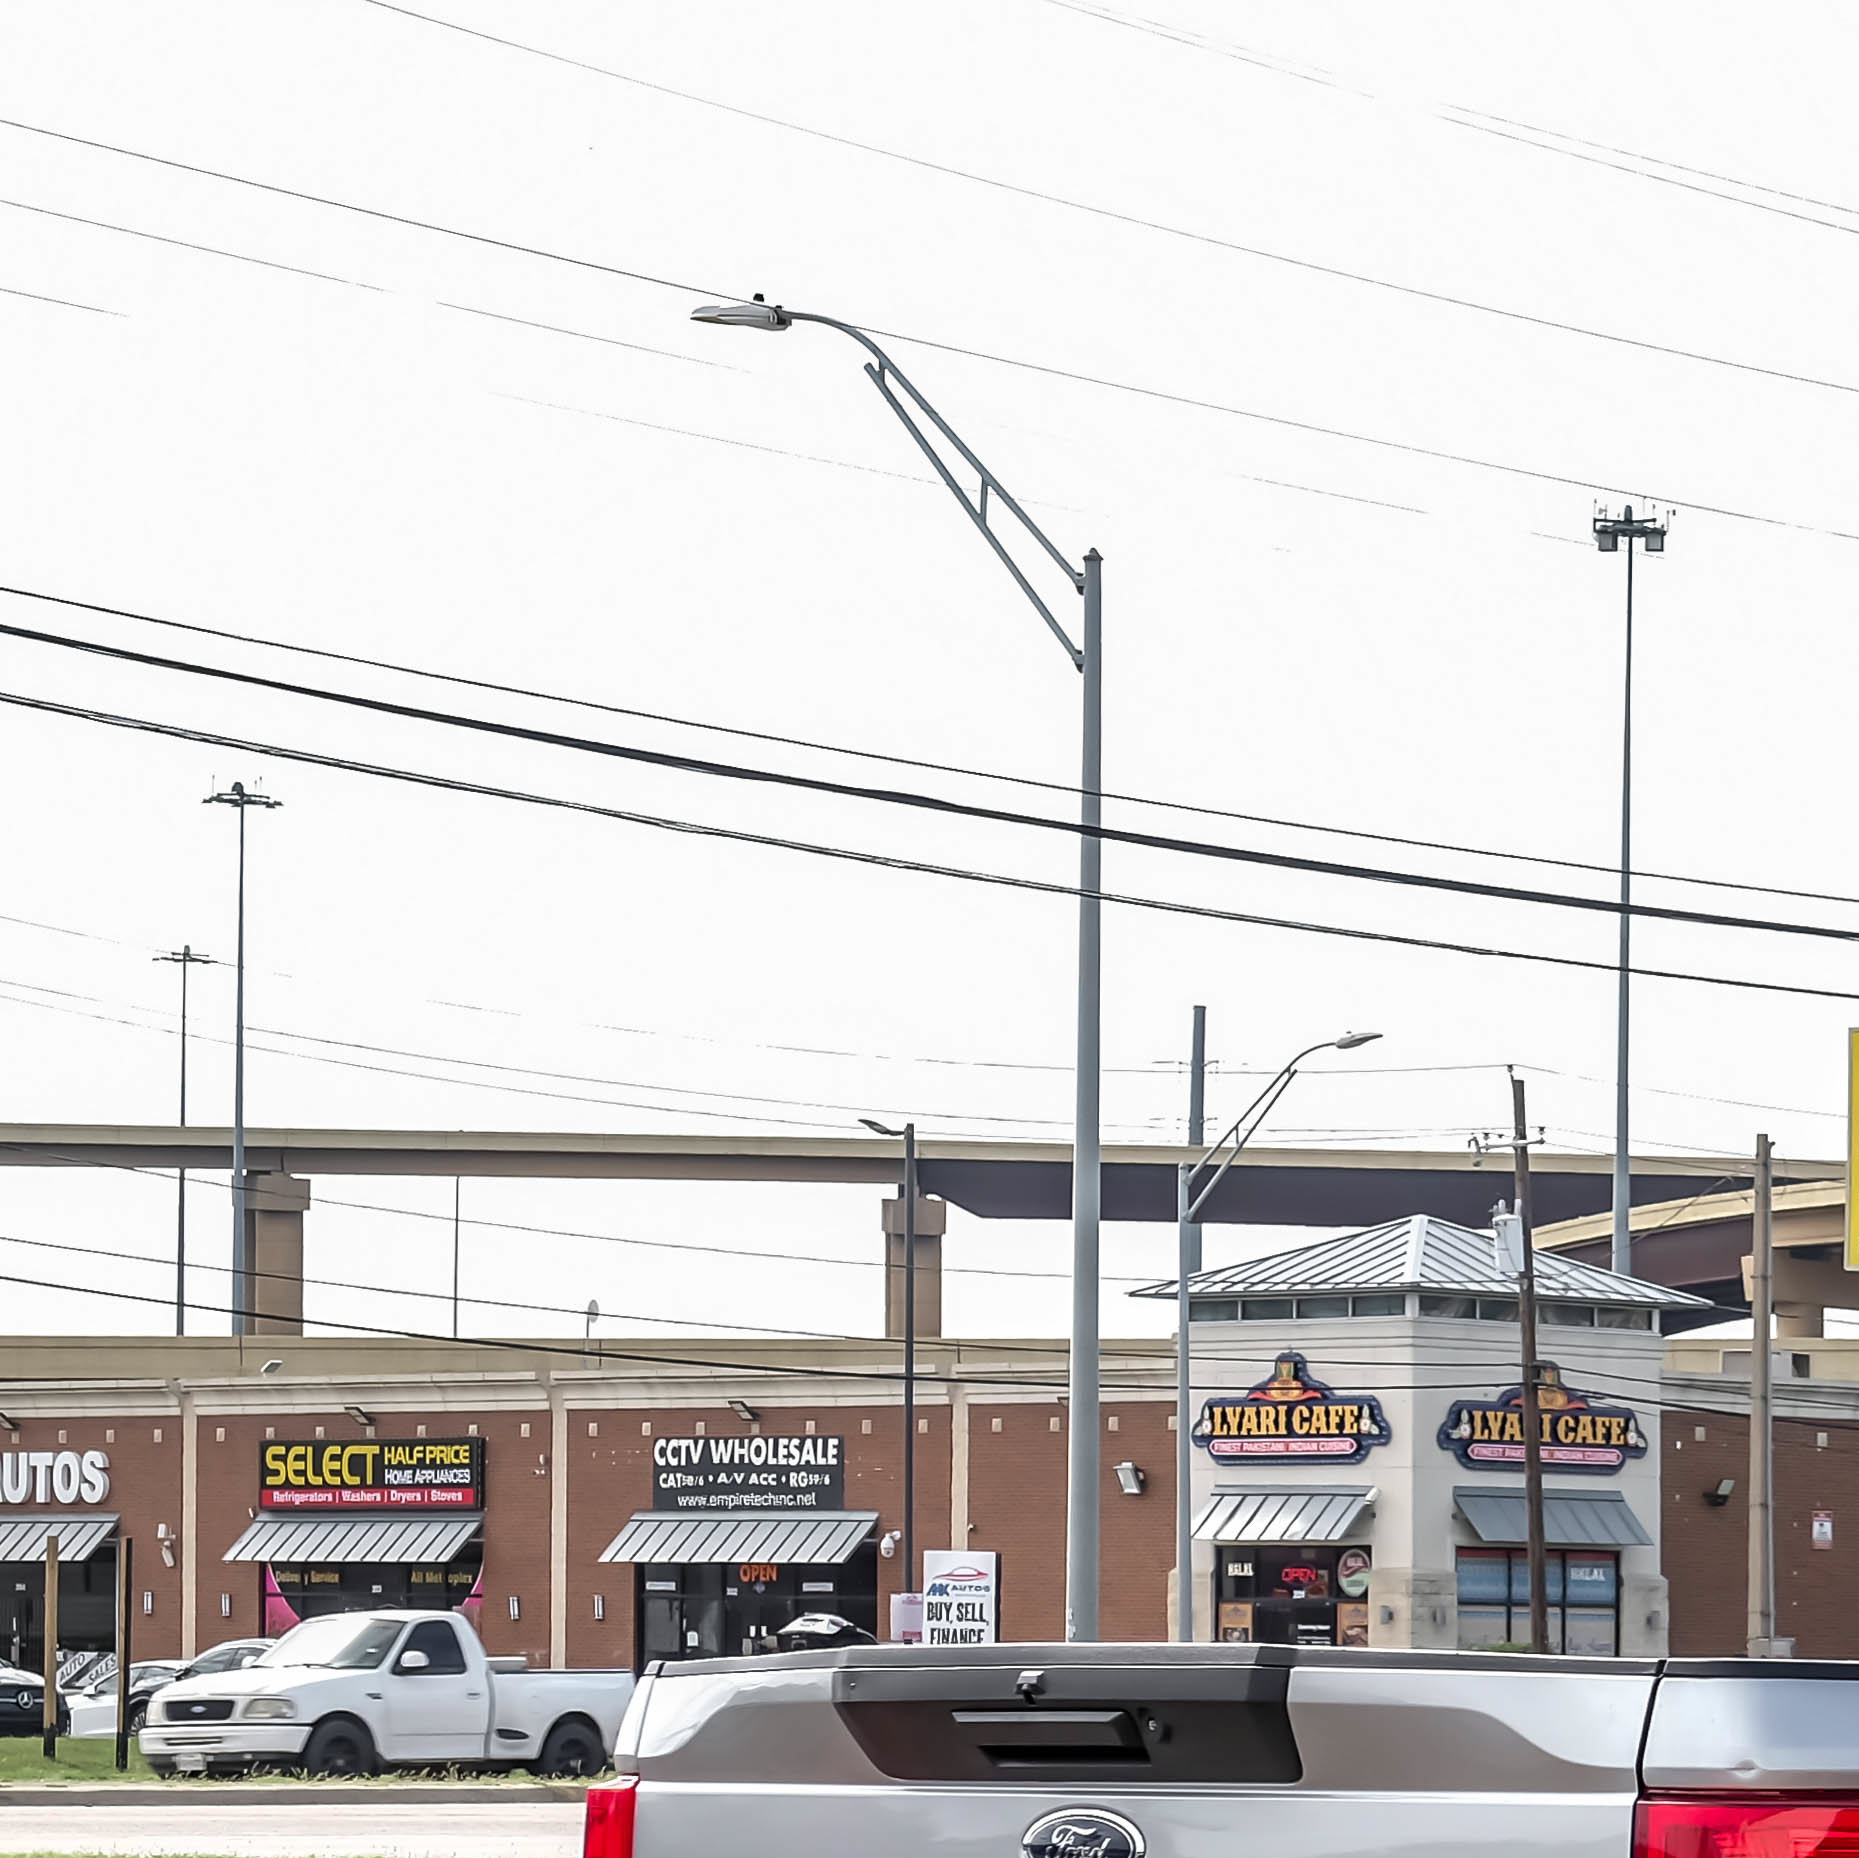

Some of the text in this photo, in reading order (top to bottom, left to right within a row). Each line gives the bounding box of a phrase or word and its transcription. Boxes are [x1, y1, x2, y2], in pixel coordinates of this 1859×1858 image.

[1212, 1405, 1358, 1436] LYARI CAFE
[1472, 1410, 1625, 1445] LYAI CAFE
[266, 1445, 470, 1486] SELECT HALF PRICE
[654, 1437, 838, 1466] CCTV WHOLESALE
[0, 1451, 109, 1504] UTOS
[385, 1468, 470, 1485] HOME APPLIANCES
[748, 1473, 777, 1485] ACC
[740, 1565, 777, 1582] OPEN
[1282, 1568, 1317, 1582] OPEN
[930, 1628, 985, 1645] FINANCE
[60, 1653, 86, 1682] AUTO
[88, 1655, 117, 1682] SALES
